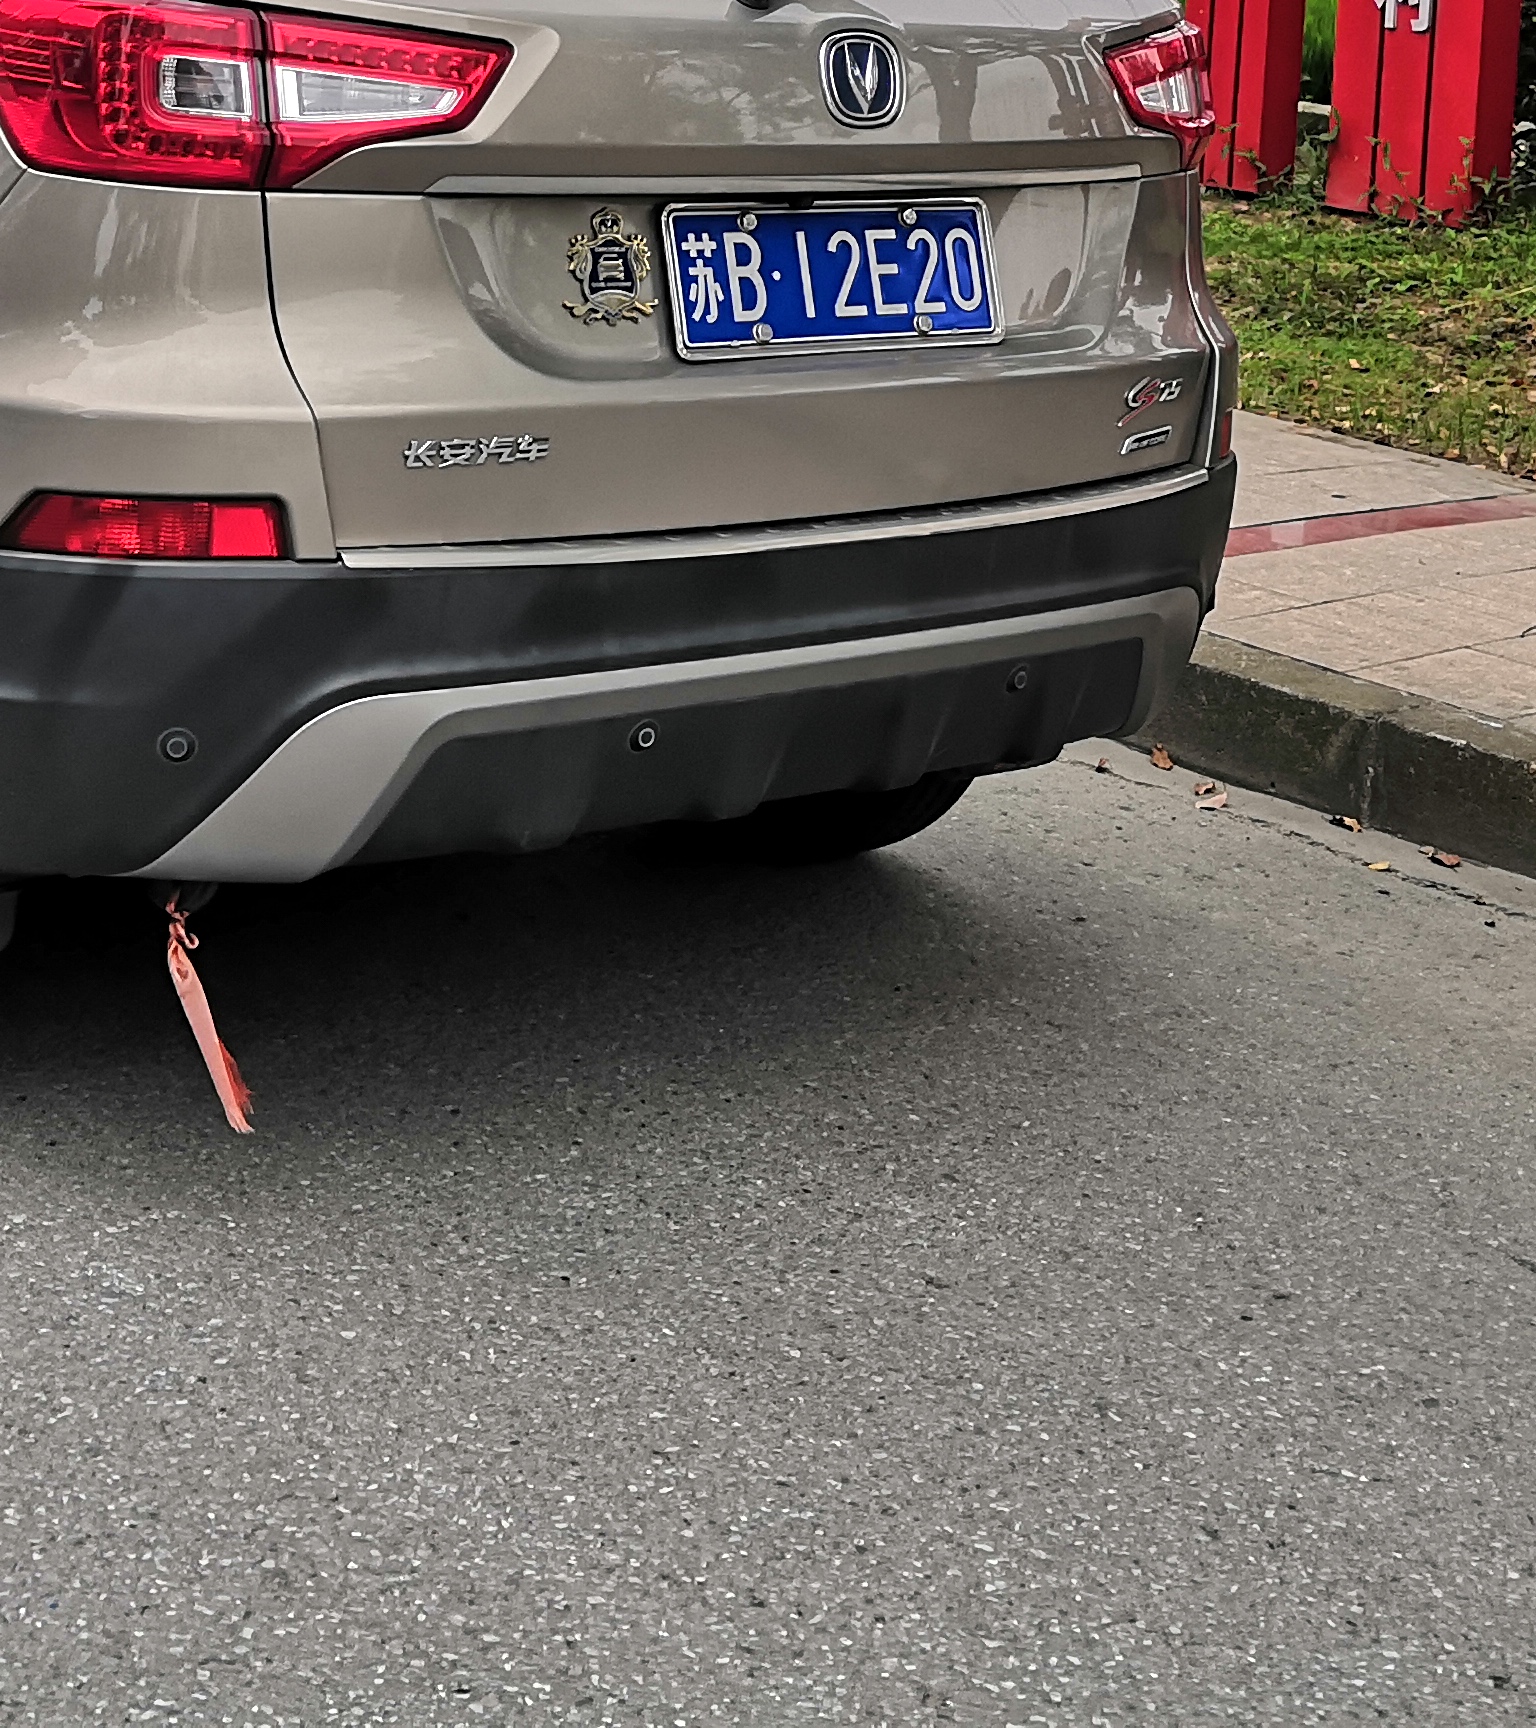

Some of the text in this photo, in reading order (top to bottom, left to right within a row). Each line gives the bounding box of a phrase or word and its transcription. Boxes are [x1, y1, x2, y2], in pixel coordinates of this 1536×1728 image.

[680, 227, 983, 324] 苏B·12E20
[403, 433, 550, 468] 长安汽车
